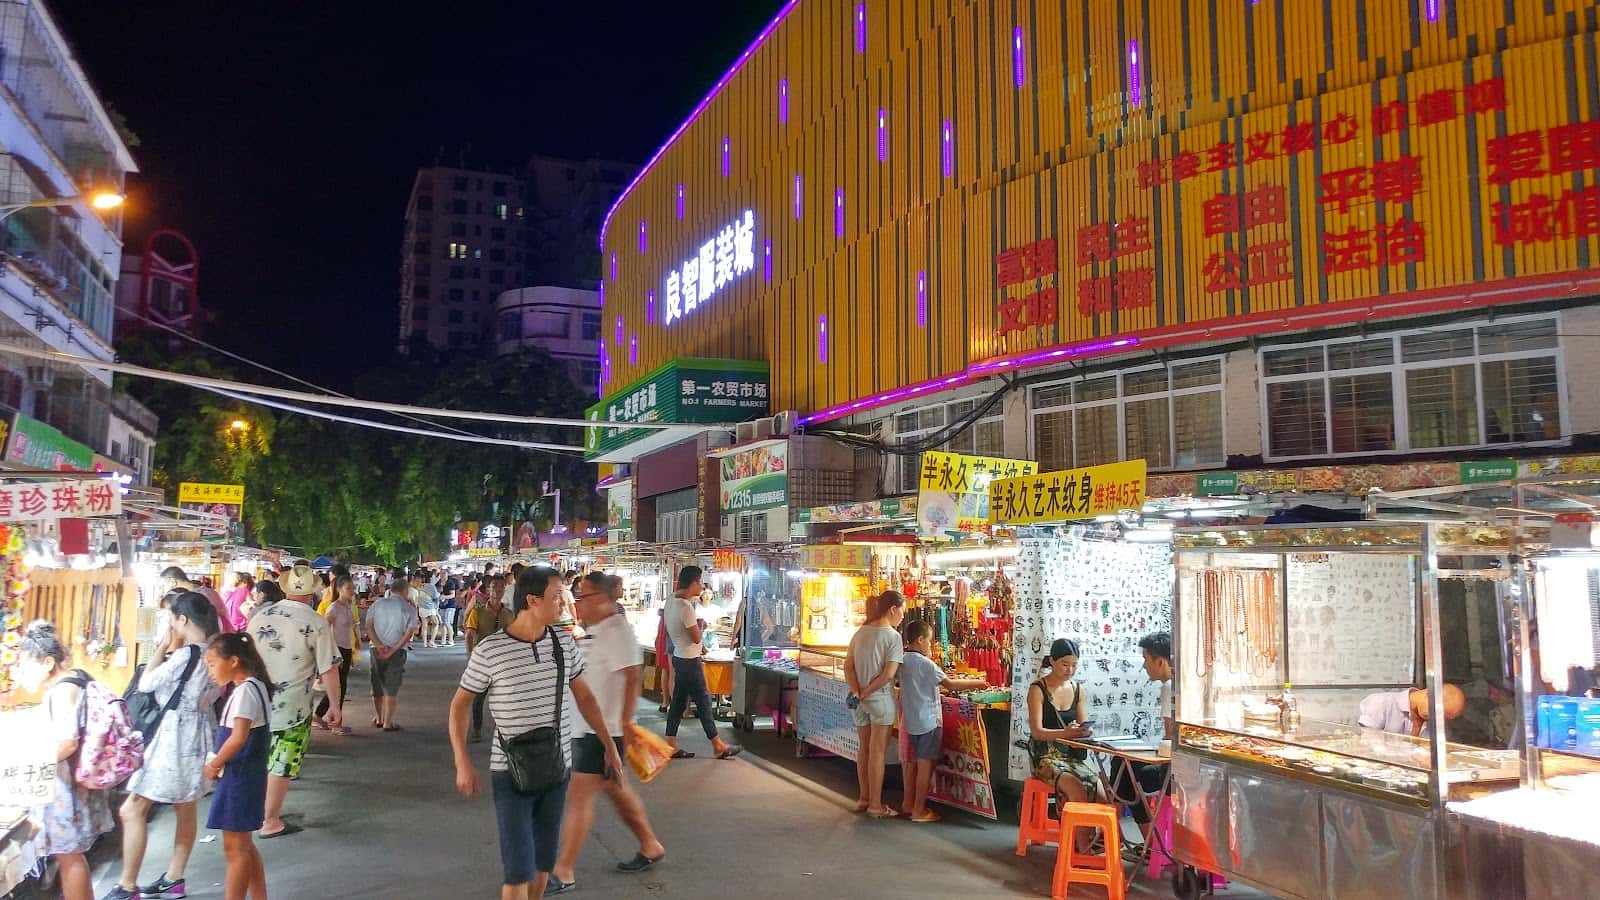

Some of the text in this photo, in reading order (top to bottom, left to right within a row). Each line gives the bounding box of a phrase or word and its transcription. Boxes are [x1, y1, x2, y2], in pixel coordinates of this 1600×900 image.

[1136, 77, 1508, 190] 社会主义核心价值观
[997, 119, 1600, 288] 富强 民主 自由 平等 爱国
[664, 208, 756, 327] 良智服装城
[996, 185, 1600, 337] 文明 和谐 公正 法治 诚信
[608, 382, 658, 423] 第一农贸市场
[681, 379, 768, 399] 第一农贸市场
[703, 398, 737, 407] FARMERS
[739, 399, 769, 408] MARKET
[991, 471, 1141, 521] 半永久艺术纹身 维持45天
